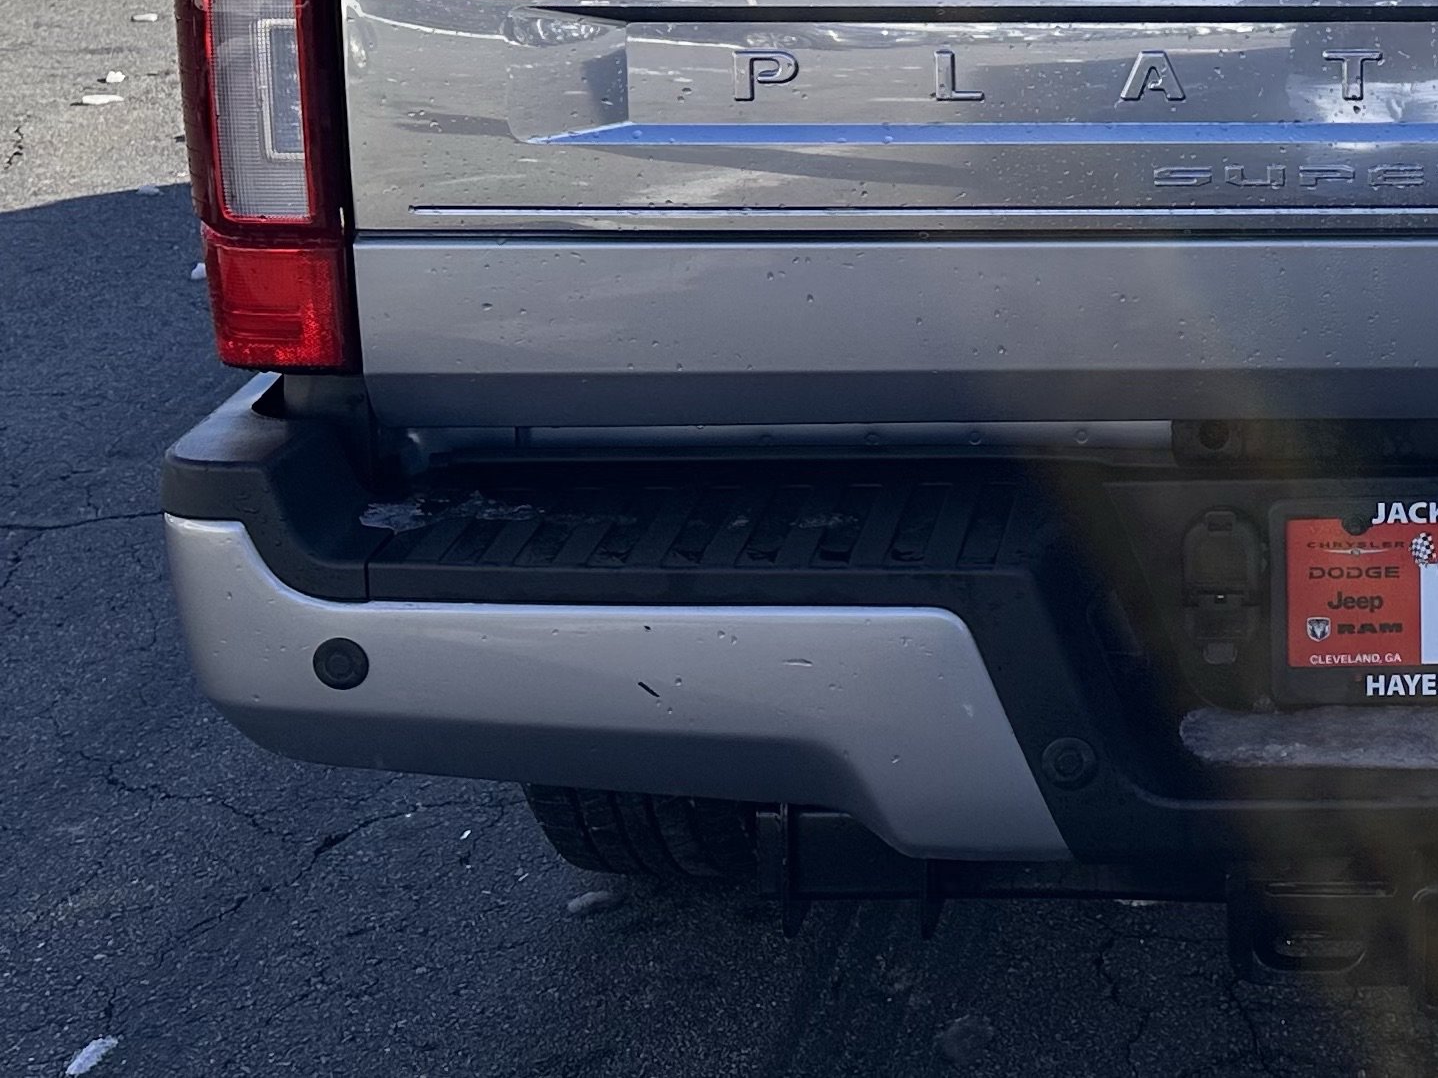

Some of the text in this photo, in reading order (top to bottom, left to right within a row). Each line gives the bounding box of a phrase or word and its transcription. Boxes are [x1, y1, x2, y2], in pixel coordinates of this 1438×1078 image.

[1306, 540, 1405, 549] CHRYSLER
[1308, 566, 1401, 580] DODGE
[1327, 590, 1384, 613] Jeep
[1337, 622, 1404, 635] RAM
[1309, 652, 1402, 665] CLEVELAND, GA
